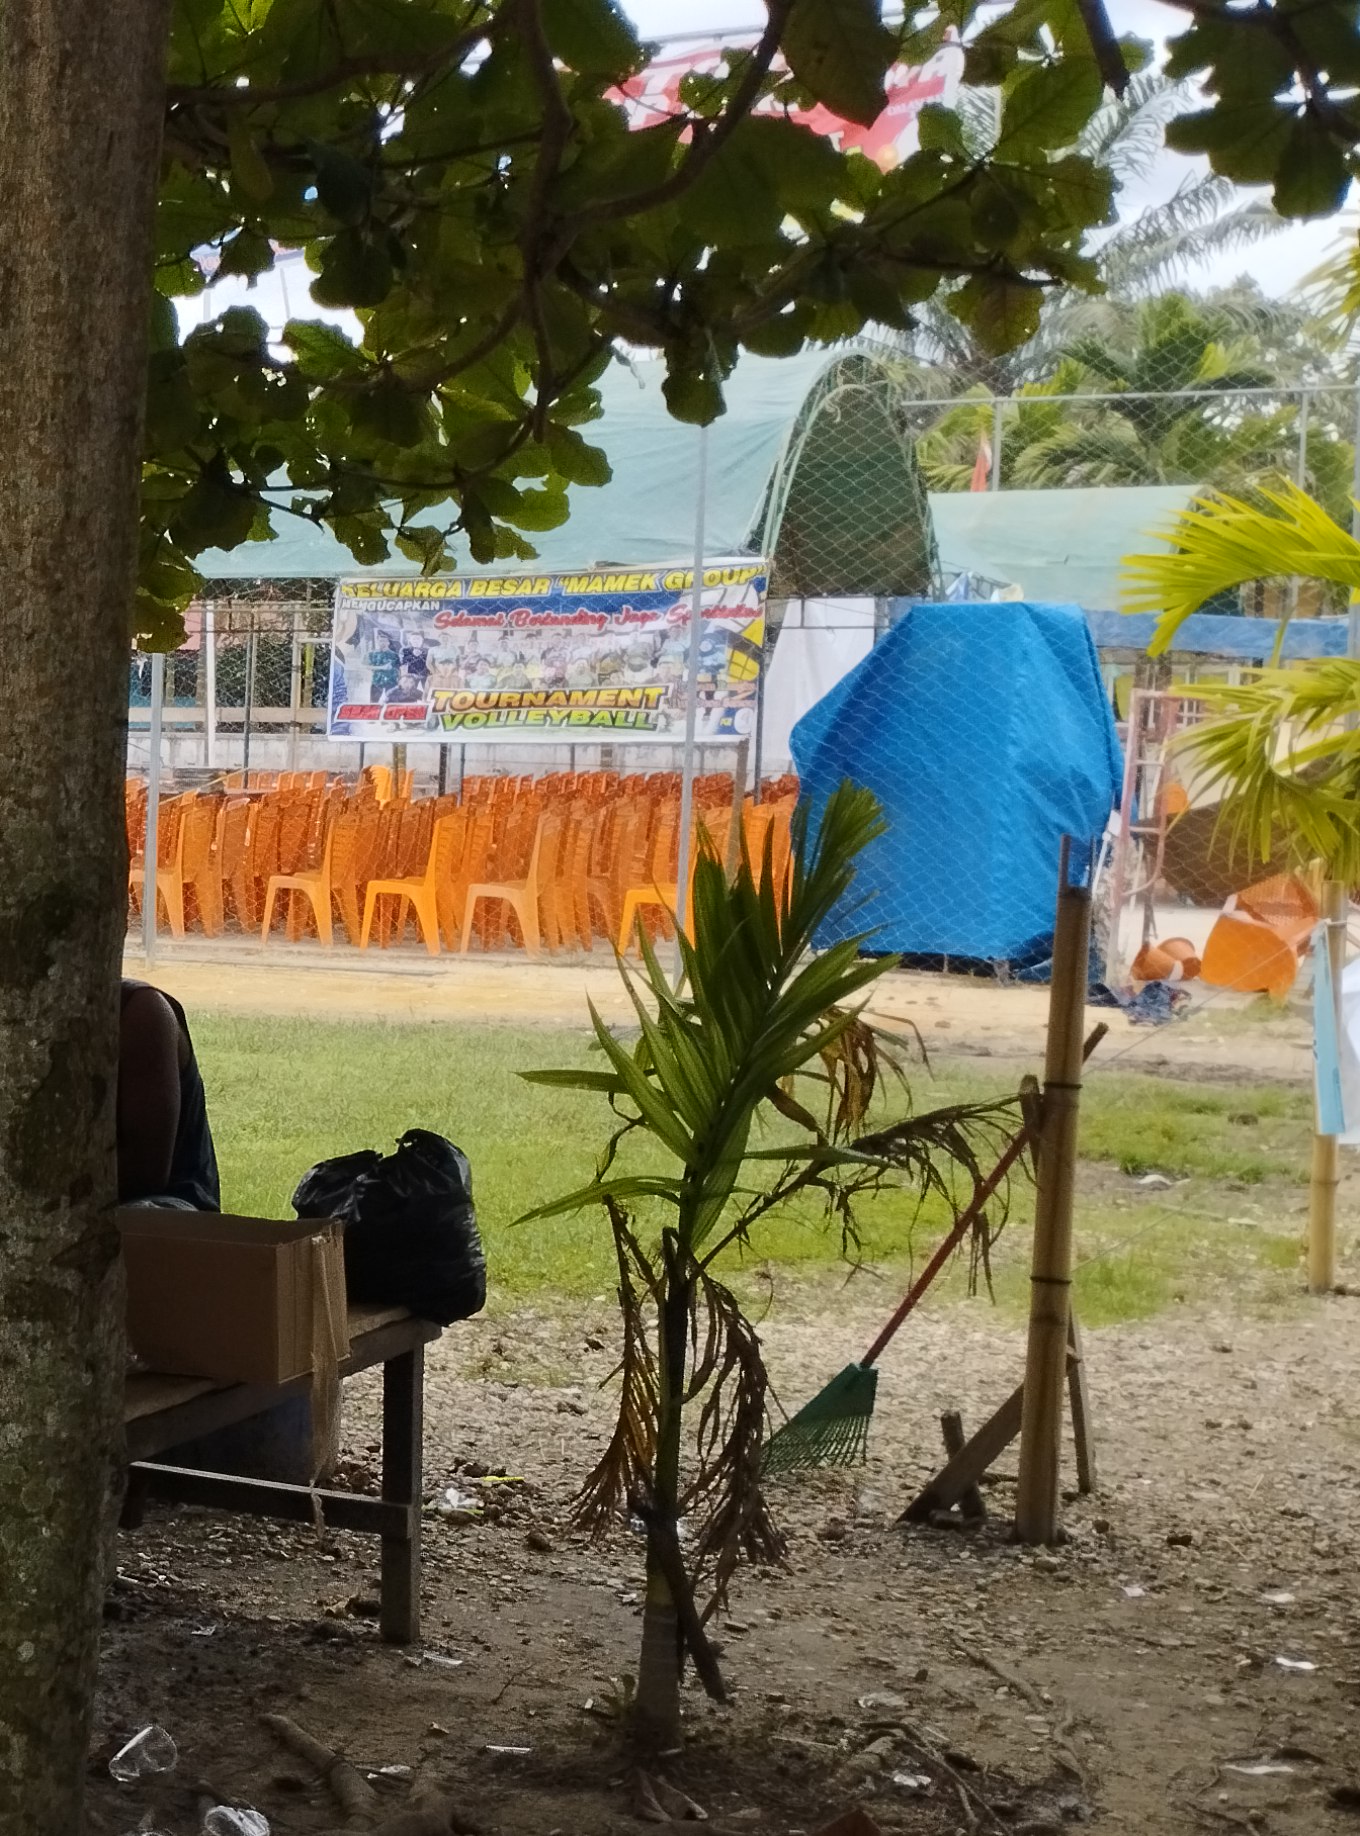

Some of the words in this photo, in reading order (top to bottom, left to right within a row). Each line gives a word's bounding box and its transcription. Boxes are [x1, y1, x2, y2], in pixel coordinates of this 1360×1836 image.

[341, 581, 462, 598] KELUARGA
[468, 577, 551, 597] BESAR
[341, 599, 440, 612] MENGUCAPKAN
[433, 687, 667, 714] TOURNAMENT
[440, 708, 659, 732] VOLLEYBALL
